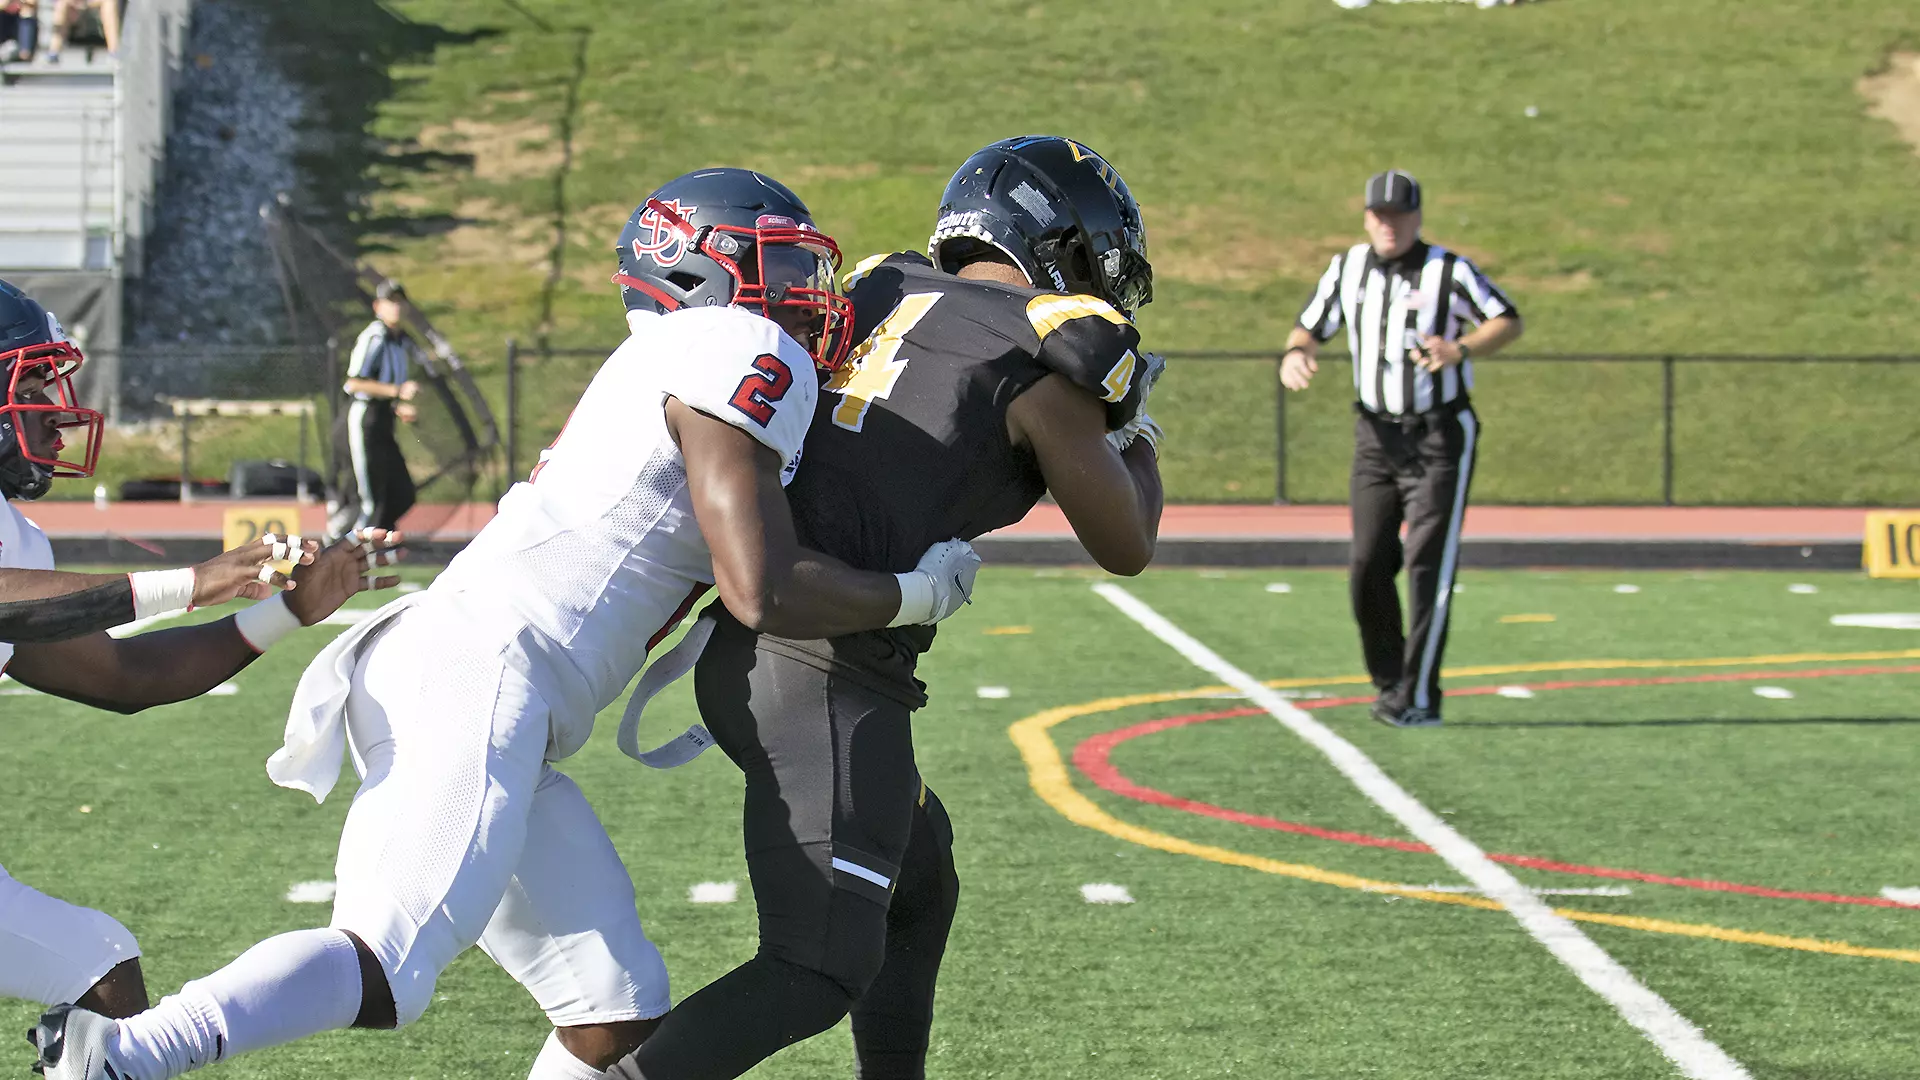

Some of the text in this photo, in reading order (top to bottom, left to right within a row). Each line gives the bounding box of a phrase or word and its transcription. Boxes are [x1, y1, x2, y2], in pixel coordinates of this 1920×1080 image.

[727, 352, 794, 429] 2
[821, 291, 945, 434] 4
[1099, 348, 1132, 402] 4
